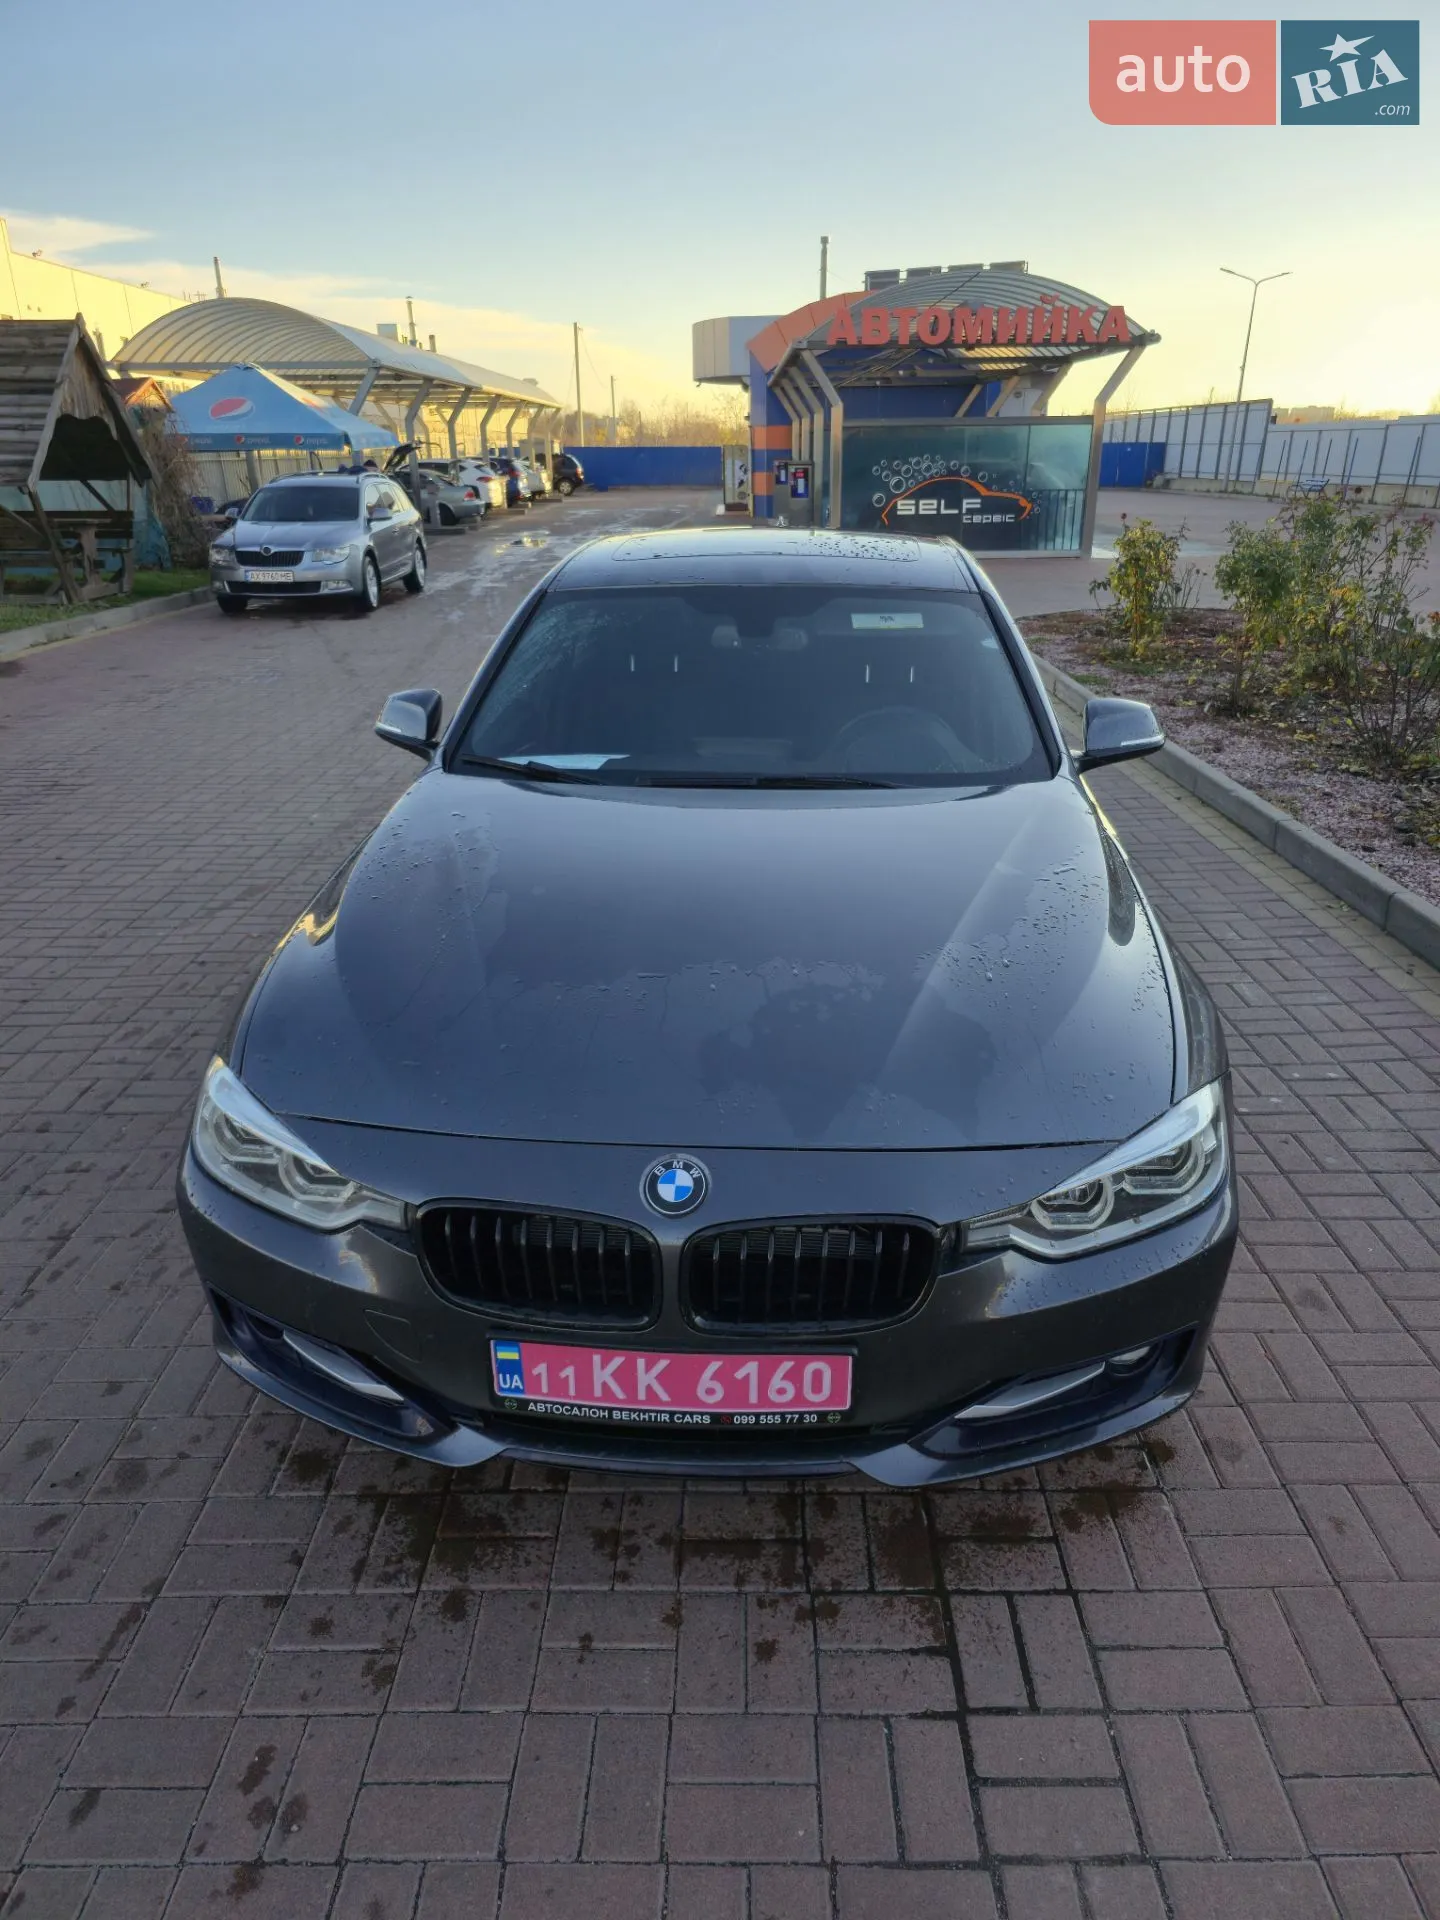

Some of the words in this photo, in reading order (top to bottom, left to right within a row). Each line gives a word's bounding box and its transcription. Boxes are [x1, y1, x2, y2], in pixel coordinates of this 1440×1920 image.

[826, 293, 1132, 346] АВТОМИЙКА
[654, 1160, 701, 1178] BMW
[498, 1373, 523, 1391] UA
[531, 1362, 577, 1397] 11
[592, 1353, 671, 1404] KK
[696, 1360, 832, 1404] 6160
[527, 1402, 608, 1418] АВТОСАЛОН
[613, 1410, 670, 1422] BEKHTIR
[673, 1413, 711, 1424] CARS
[733, 1415, 755, 1424] 099
[759, 1414, 781, 1424] 555
[784, 1414, 799, 1423] 77
[803, 1413, 818, 1423] 30
